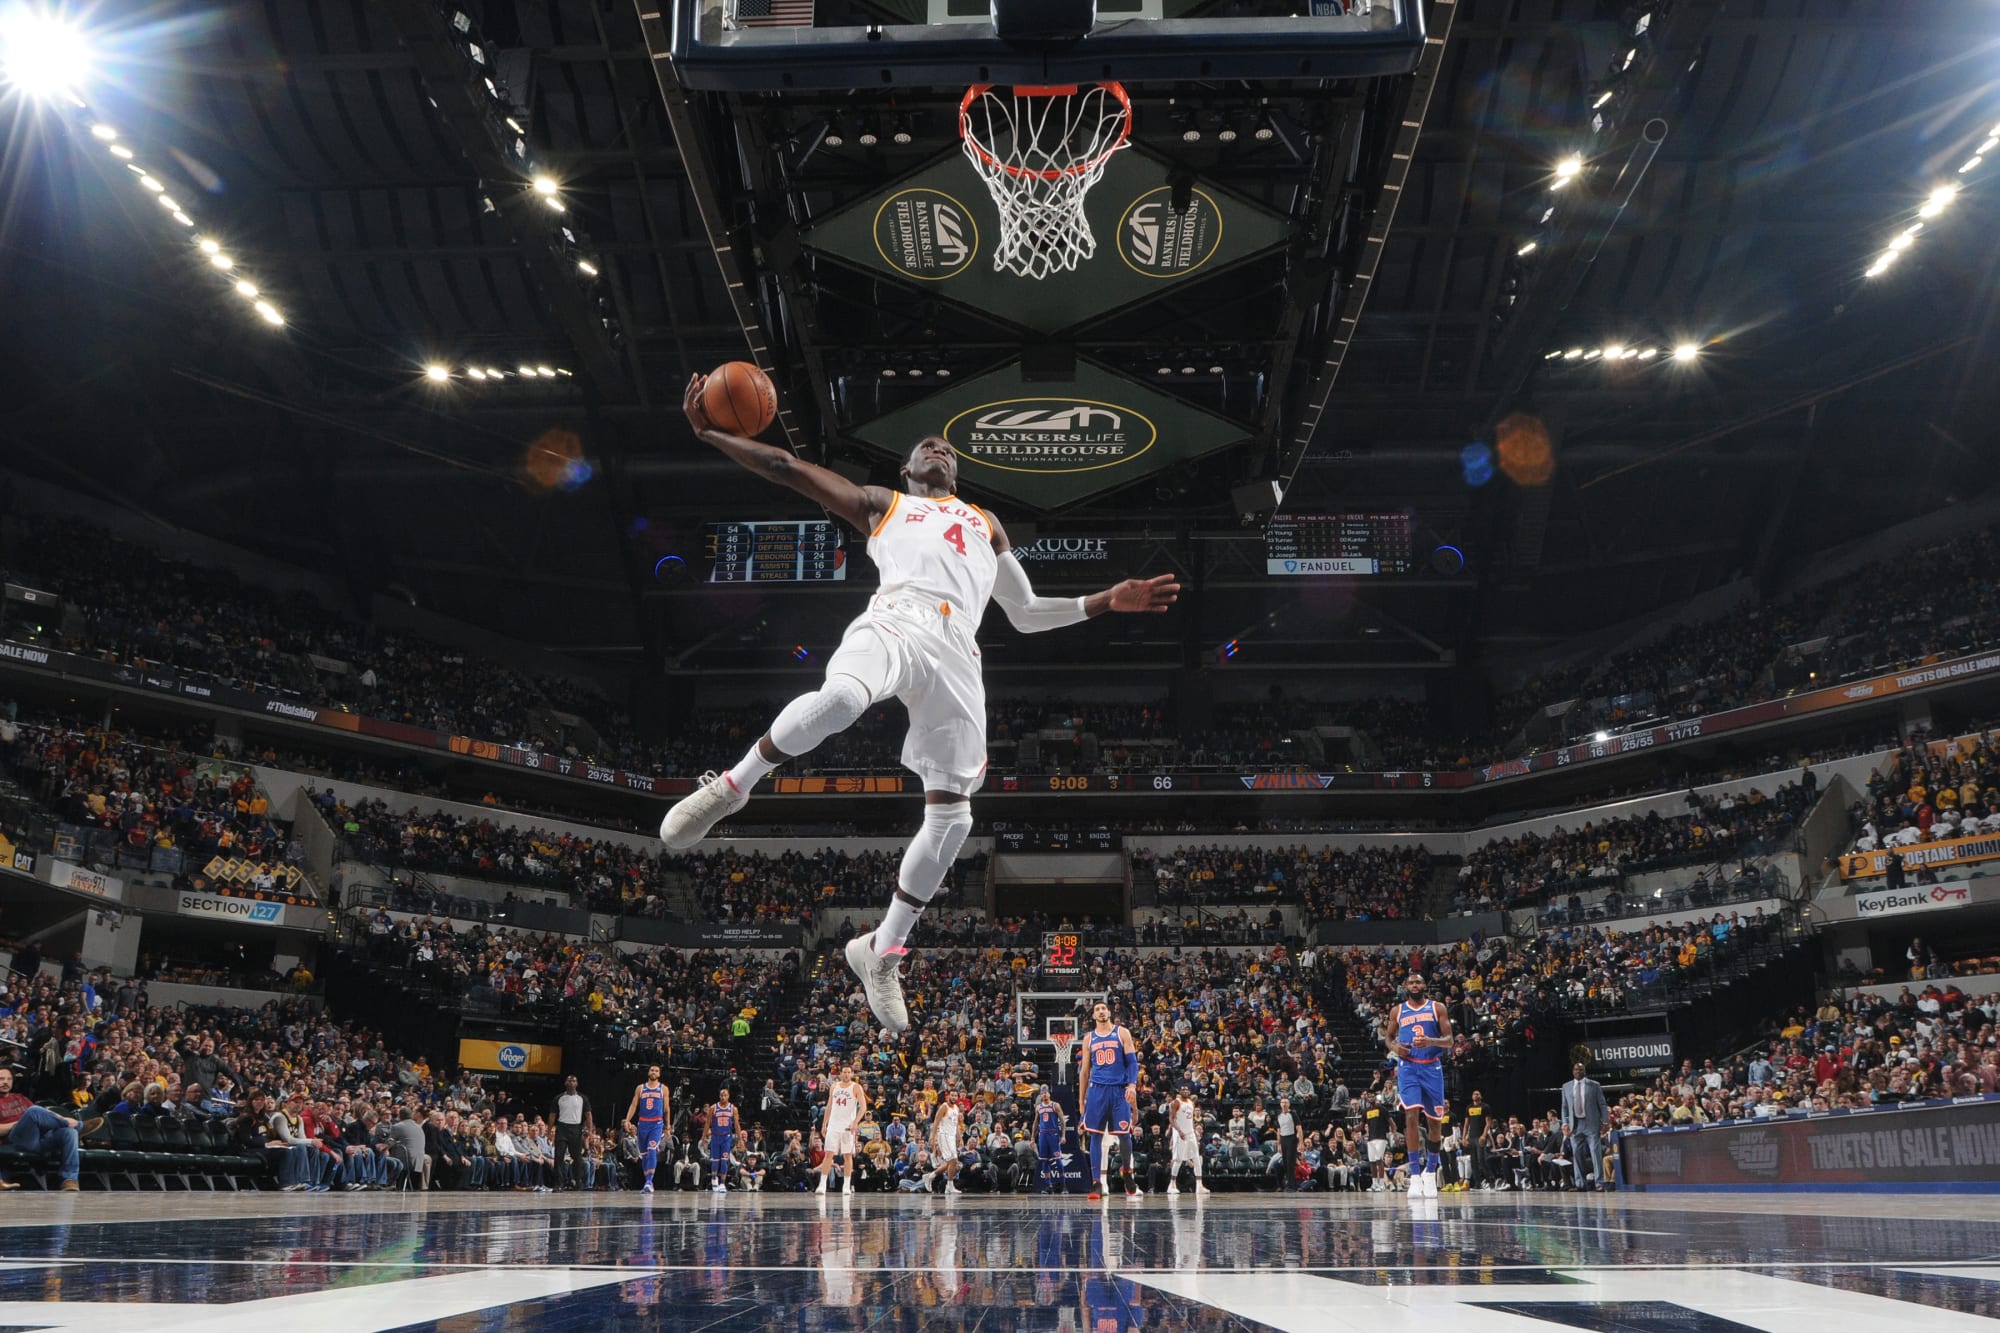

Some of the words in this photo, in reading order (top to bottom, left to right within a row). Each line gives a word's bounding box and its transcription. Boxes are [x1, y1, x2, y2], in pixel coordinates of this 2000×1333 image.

[1316, 3, 1337, 16] NBA
[916, 201, 932, 250] BANKERS
[896, 201, 917, 268] FIELDHOUSE
[1179, 199, 1199, 267] FIELDHOUSE
[1161, 220, 1177, 267] BANKERS
[922, 250, 935, 268] LIFE
[970, 433, 1082, 442] BANKERS
[1085, 433, 1126, 442] LIFE
[971, 446, 1124, 455] FIELDHOUSE
[727, 526, 738, 534] 54
[814, 524, 826, 532] 45
[943, 523, 967, 557] 4
[1029, 553, 1056, 561] HOME
[1058, 552, 1108, 560] MORTGAGE
[726, 563, 737, 571] 17
[814, 561, 824, 569] 16
[1301, 562, 1356, 571] FANDUEL
[23, 649, 48, 664] NOW
[1896, 669, 1935, 688] TICKETS
[1936, 667, 1950, 680] ON
[1950, 663, 1976, 676] SALE
[1976, 656, 2000, 670] NOW
[266, 700, 318, 721] #ThisIsMay
[1668, 726, 1700, 741] 11/12
[1622, 737, 1654, 751] 25/55
[1590, 747, 1604, 757] 16
[526, 756, 539, 768] 30
[1557, 754, 1570, 766] 24
[559, 764, 570, 775] 17
[587, 770, 615, 784] 29/54
[1050, 776, 1088, 790] 9:08
[1153, 776, 1172, 790] 66
[1424, 778, 1431, 787] 5
[627, 778, 653, 792] 11/14
[1003, 781, 1018, 791] 22
[1110, 780, 1118, 790] 3
[14, 853, 34, 871] CAT
[1906, 846, 1956, 865] OCTANE
[182, 897, 250, 915] SECTION
[252, 905, 276, 918] 127
[1858, 892, 1928, 912] KeyBank
[1054, 935, 1077, 946] 9:08
[1050, 946, 1075, 965] 22
[1412, 1025, 1424, 1042] 3
[501, 1048, 525, 1067] Kroger
[1096, 1049, 1115, 1065] 00
[1594, 1044, 1671, 1061] LIGHTBOUND
[646, 1098, 654, 1110] 5
[836, 1098, 847, 1106] 44
[1739, 1131, 1765, 1143] INDY
[1807, 1132, 1874, 1169] TICKETS
[1874, 1130, 1900, 1168] ON
[1901, 1126, 1950, 1167] SALE
[1951, 1123, 2000, 1166] NOW
[1051, 1170, 1082, 1179] Vicent
